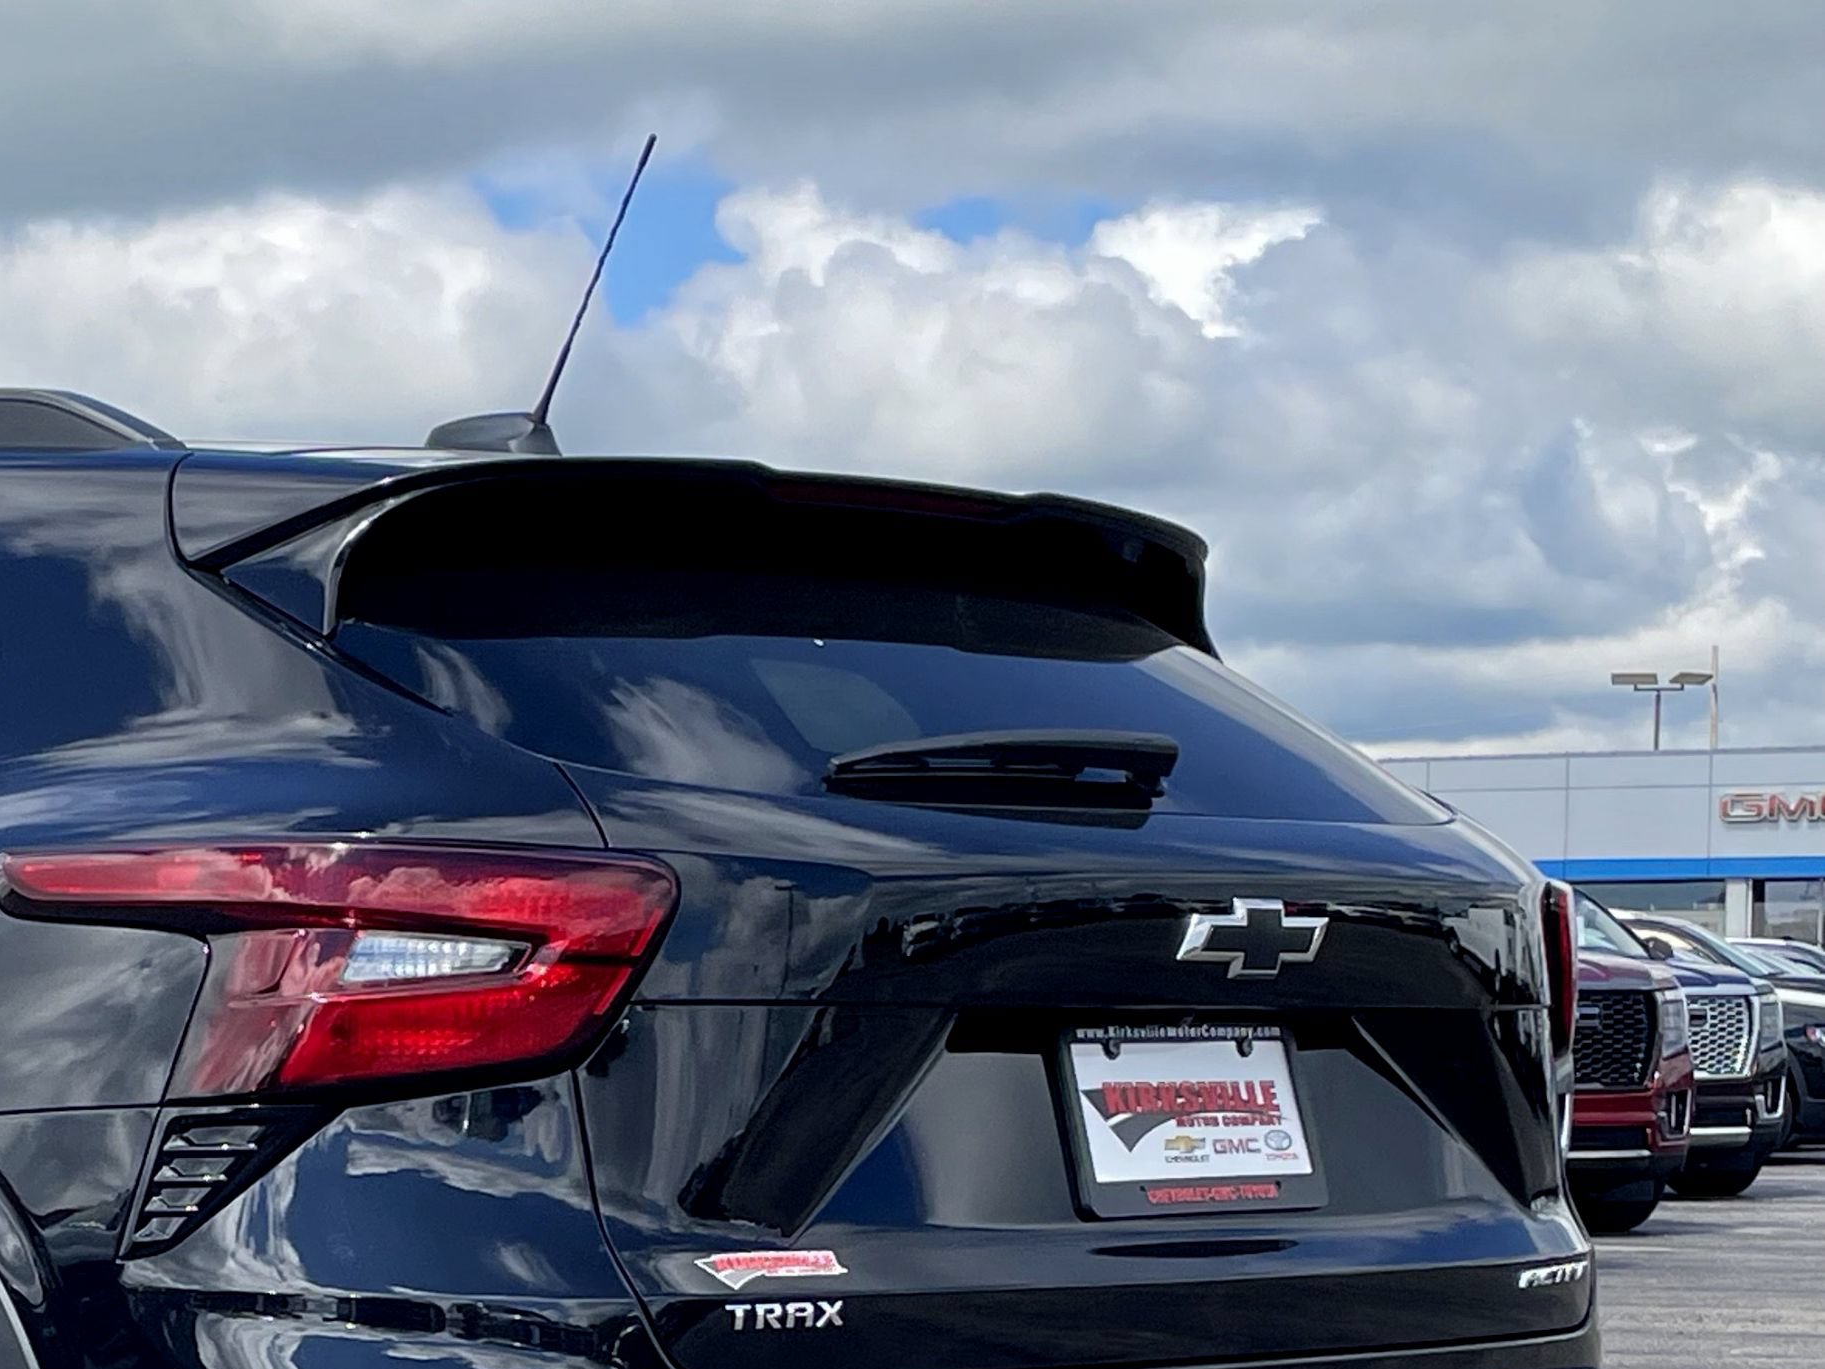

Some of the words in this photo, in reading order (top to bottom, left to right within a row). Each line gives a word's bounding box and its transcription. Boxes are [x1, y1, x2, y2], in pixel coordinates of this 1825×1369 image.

[1719, 793, 1825, 823] GM
[1102, 1080, 1280, 1114] KIRKSVILLE
[1213, 1138, 1261, 1154] GMC
[725, 1301, 844, 1331] TRAX
